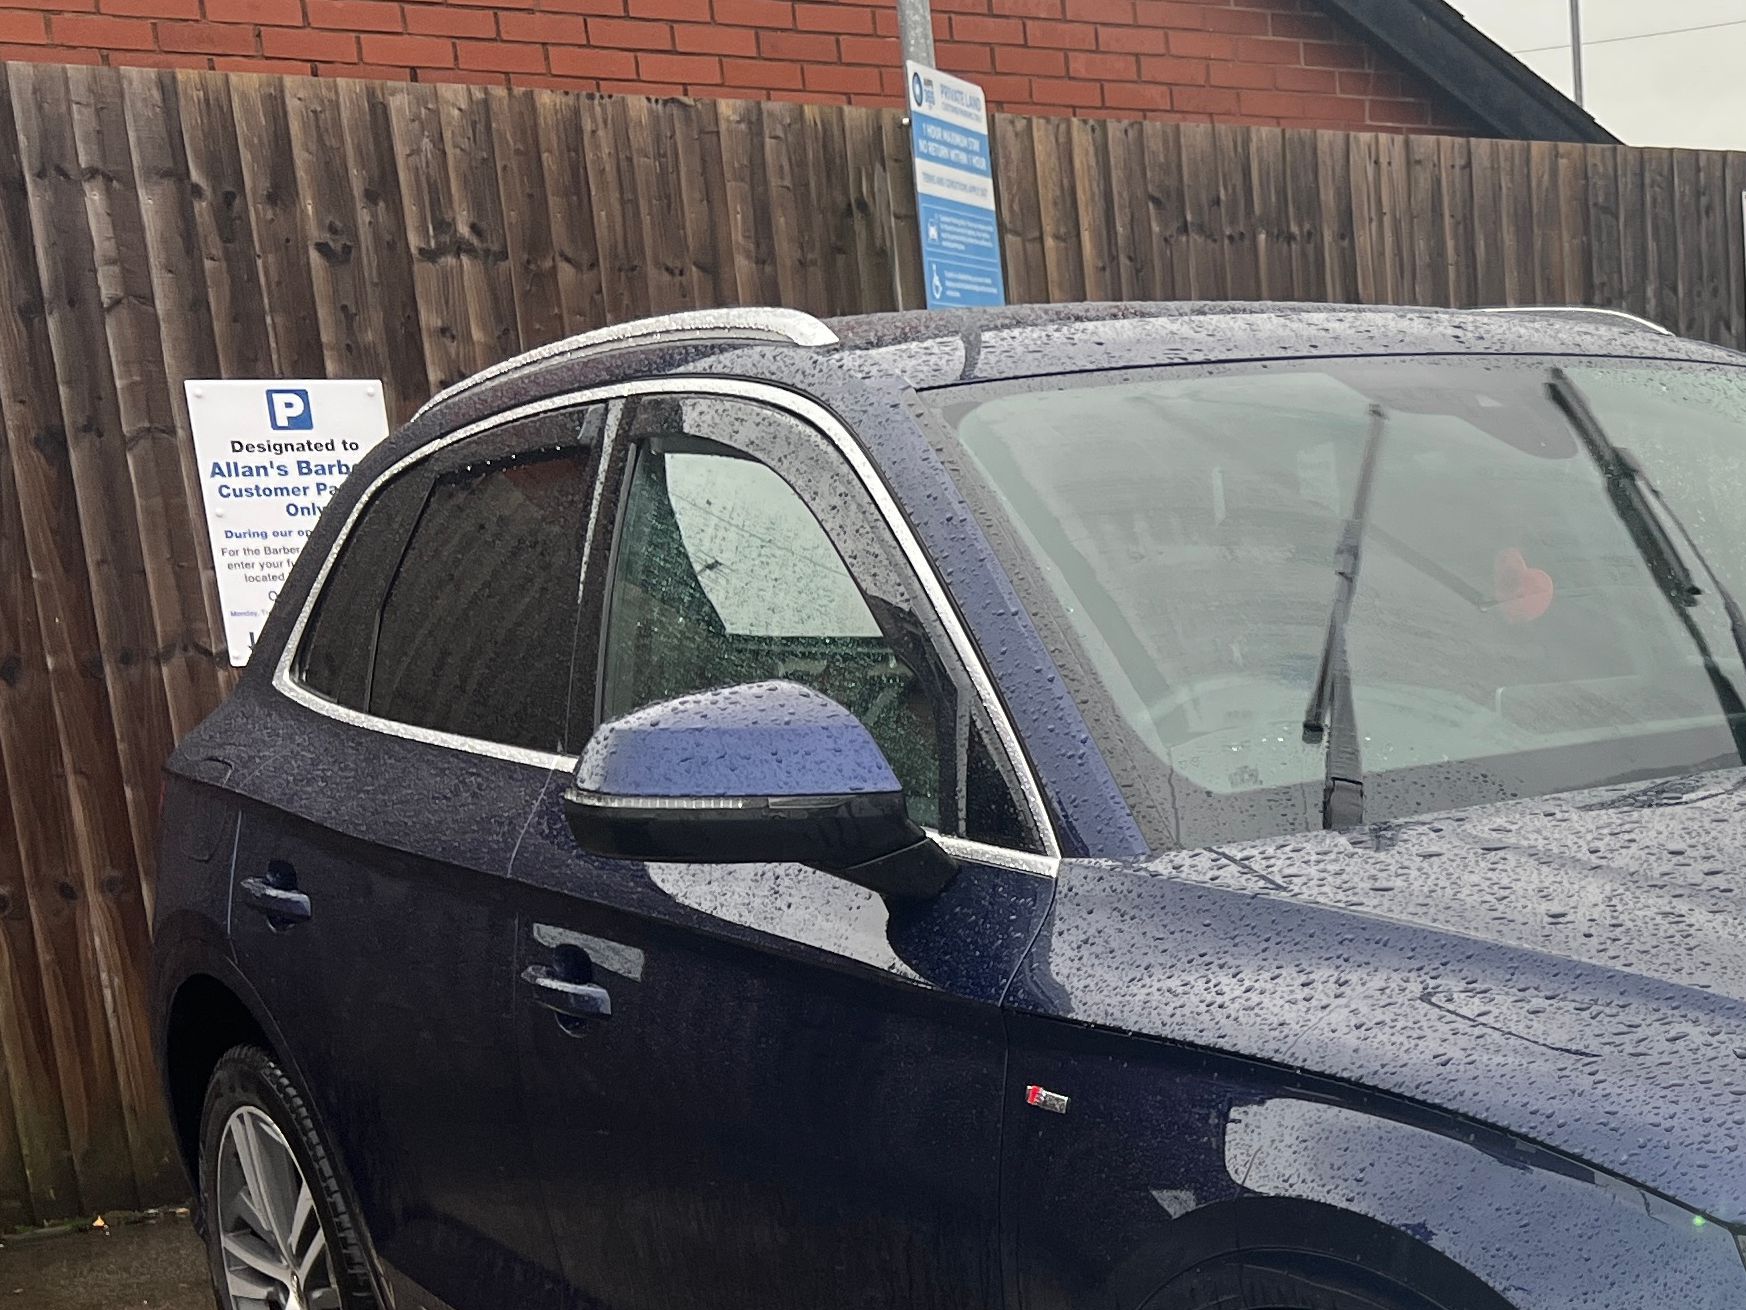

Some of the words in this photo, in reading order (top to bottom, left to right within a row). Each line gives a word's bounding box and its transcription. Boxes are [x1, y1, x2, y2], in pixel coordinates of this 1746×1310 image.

[271, 393, 304, 427] P
[230, 439, 335, 455] Designated
[341, 439, 359, 451] to
[210, 460, 289, 478] Allan's
[218, 484, 310, 499] Customer
[224, 529, 268, 540] During
[272, 530, 293, 538] our
[221, 547, 239, 557] For
[243, 547, 260, 556] the
[264, 546, 300, 555] Barber
[227, 561, 255, 570] enter
[259, 560, 283, 571] your
[244, 572, 285, 583] located
